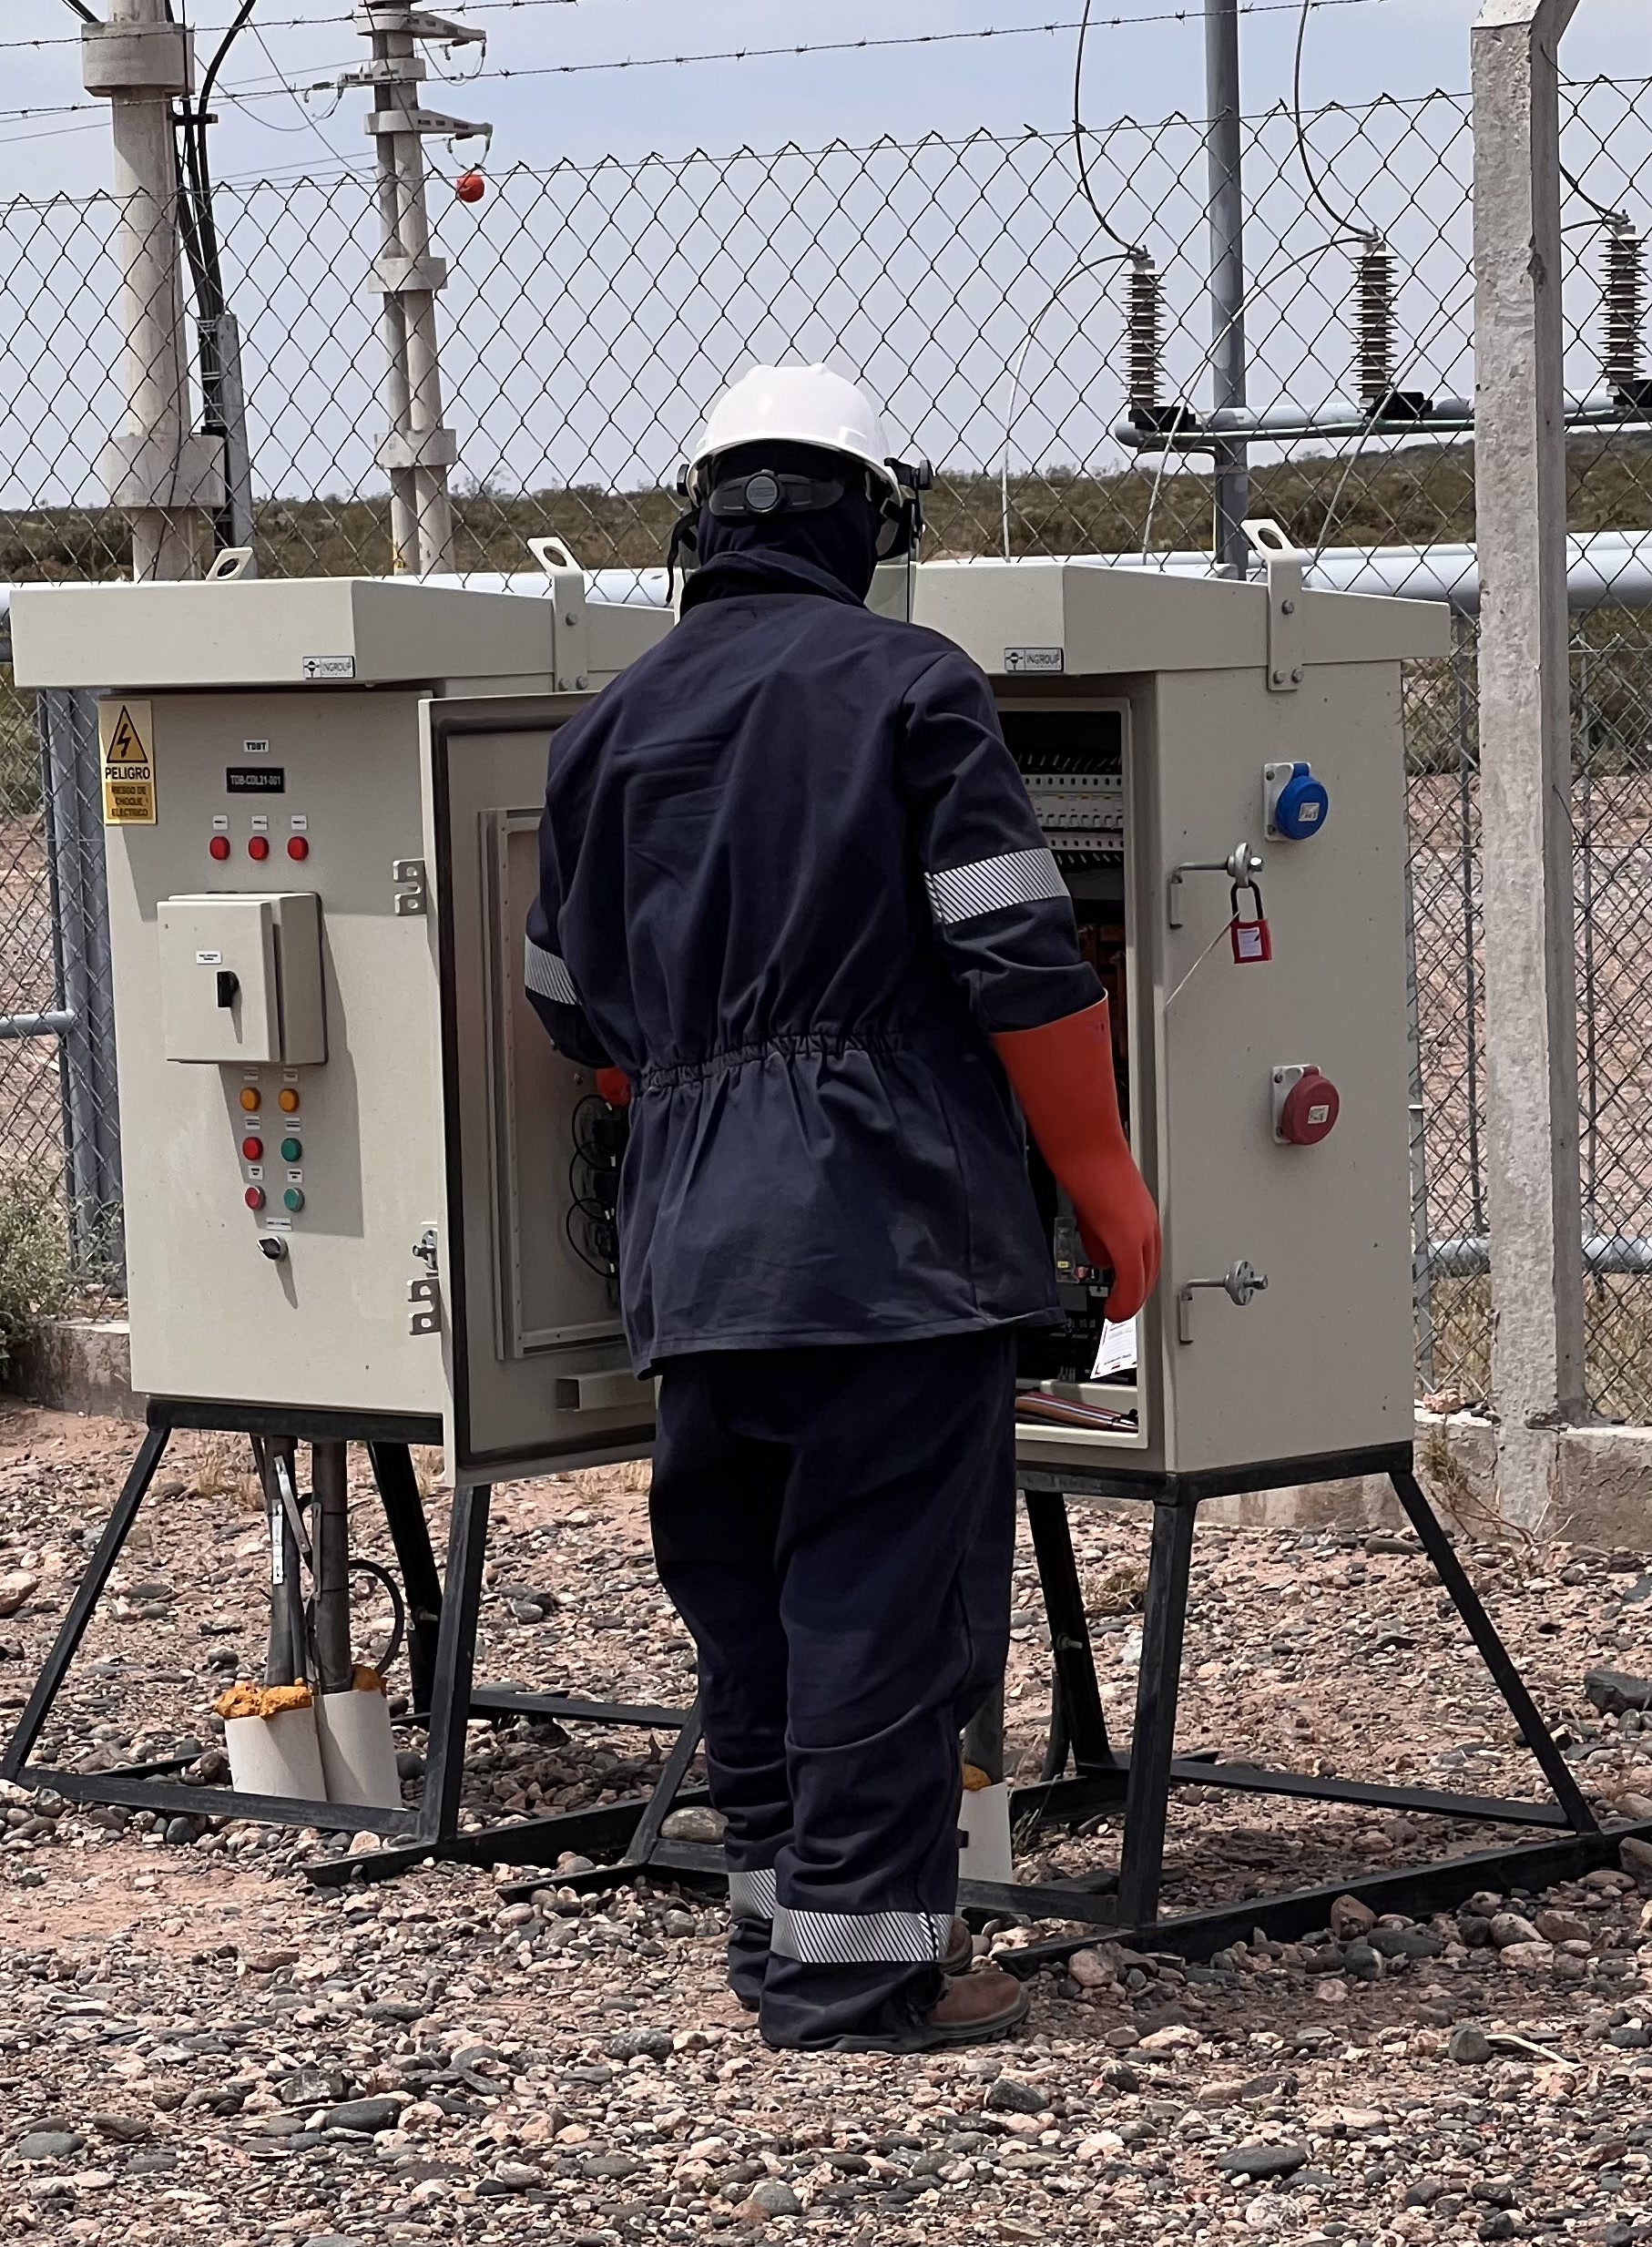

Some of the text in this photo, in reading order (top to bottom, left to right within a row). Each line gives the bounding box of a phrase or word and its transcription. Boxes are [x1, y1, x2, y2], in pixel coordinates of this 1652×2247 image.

[105, 766, 151, 780] PELIGRO
[111, 786, 147, 795] RIESGO DE
[115, 797, 144, 806] CHOQUE
